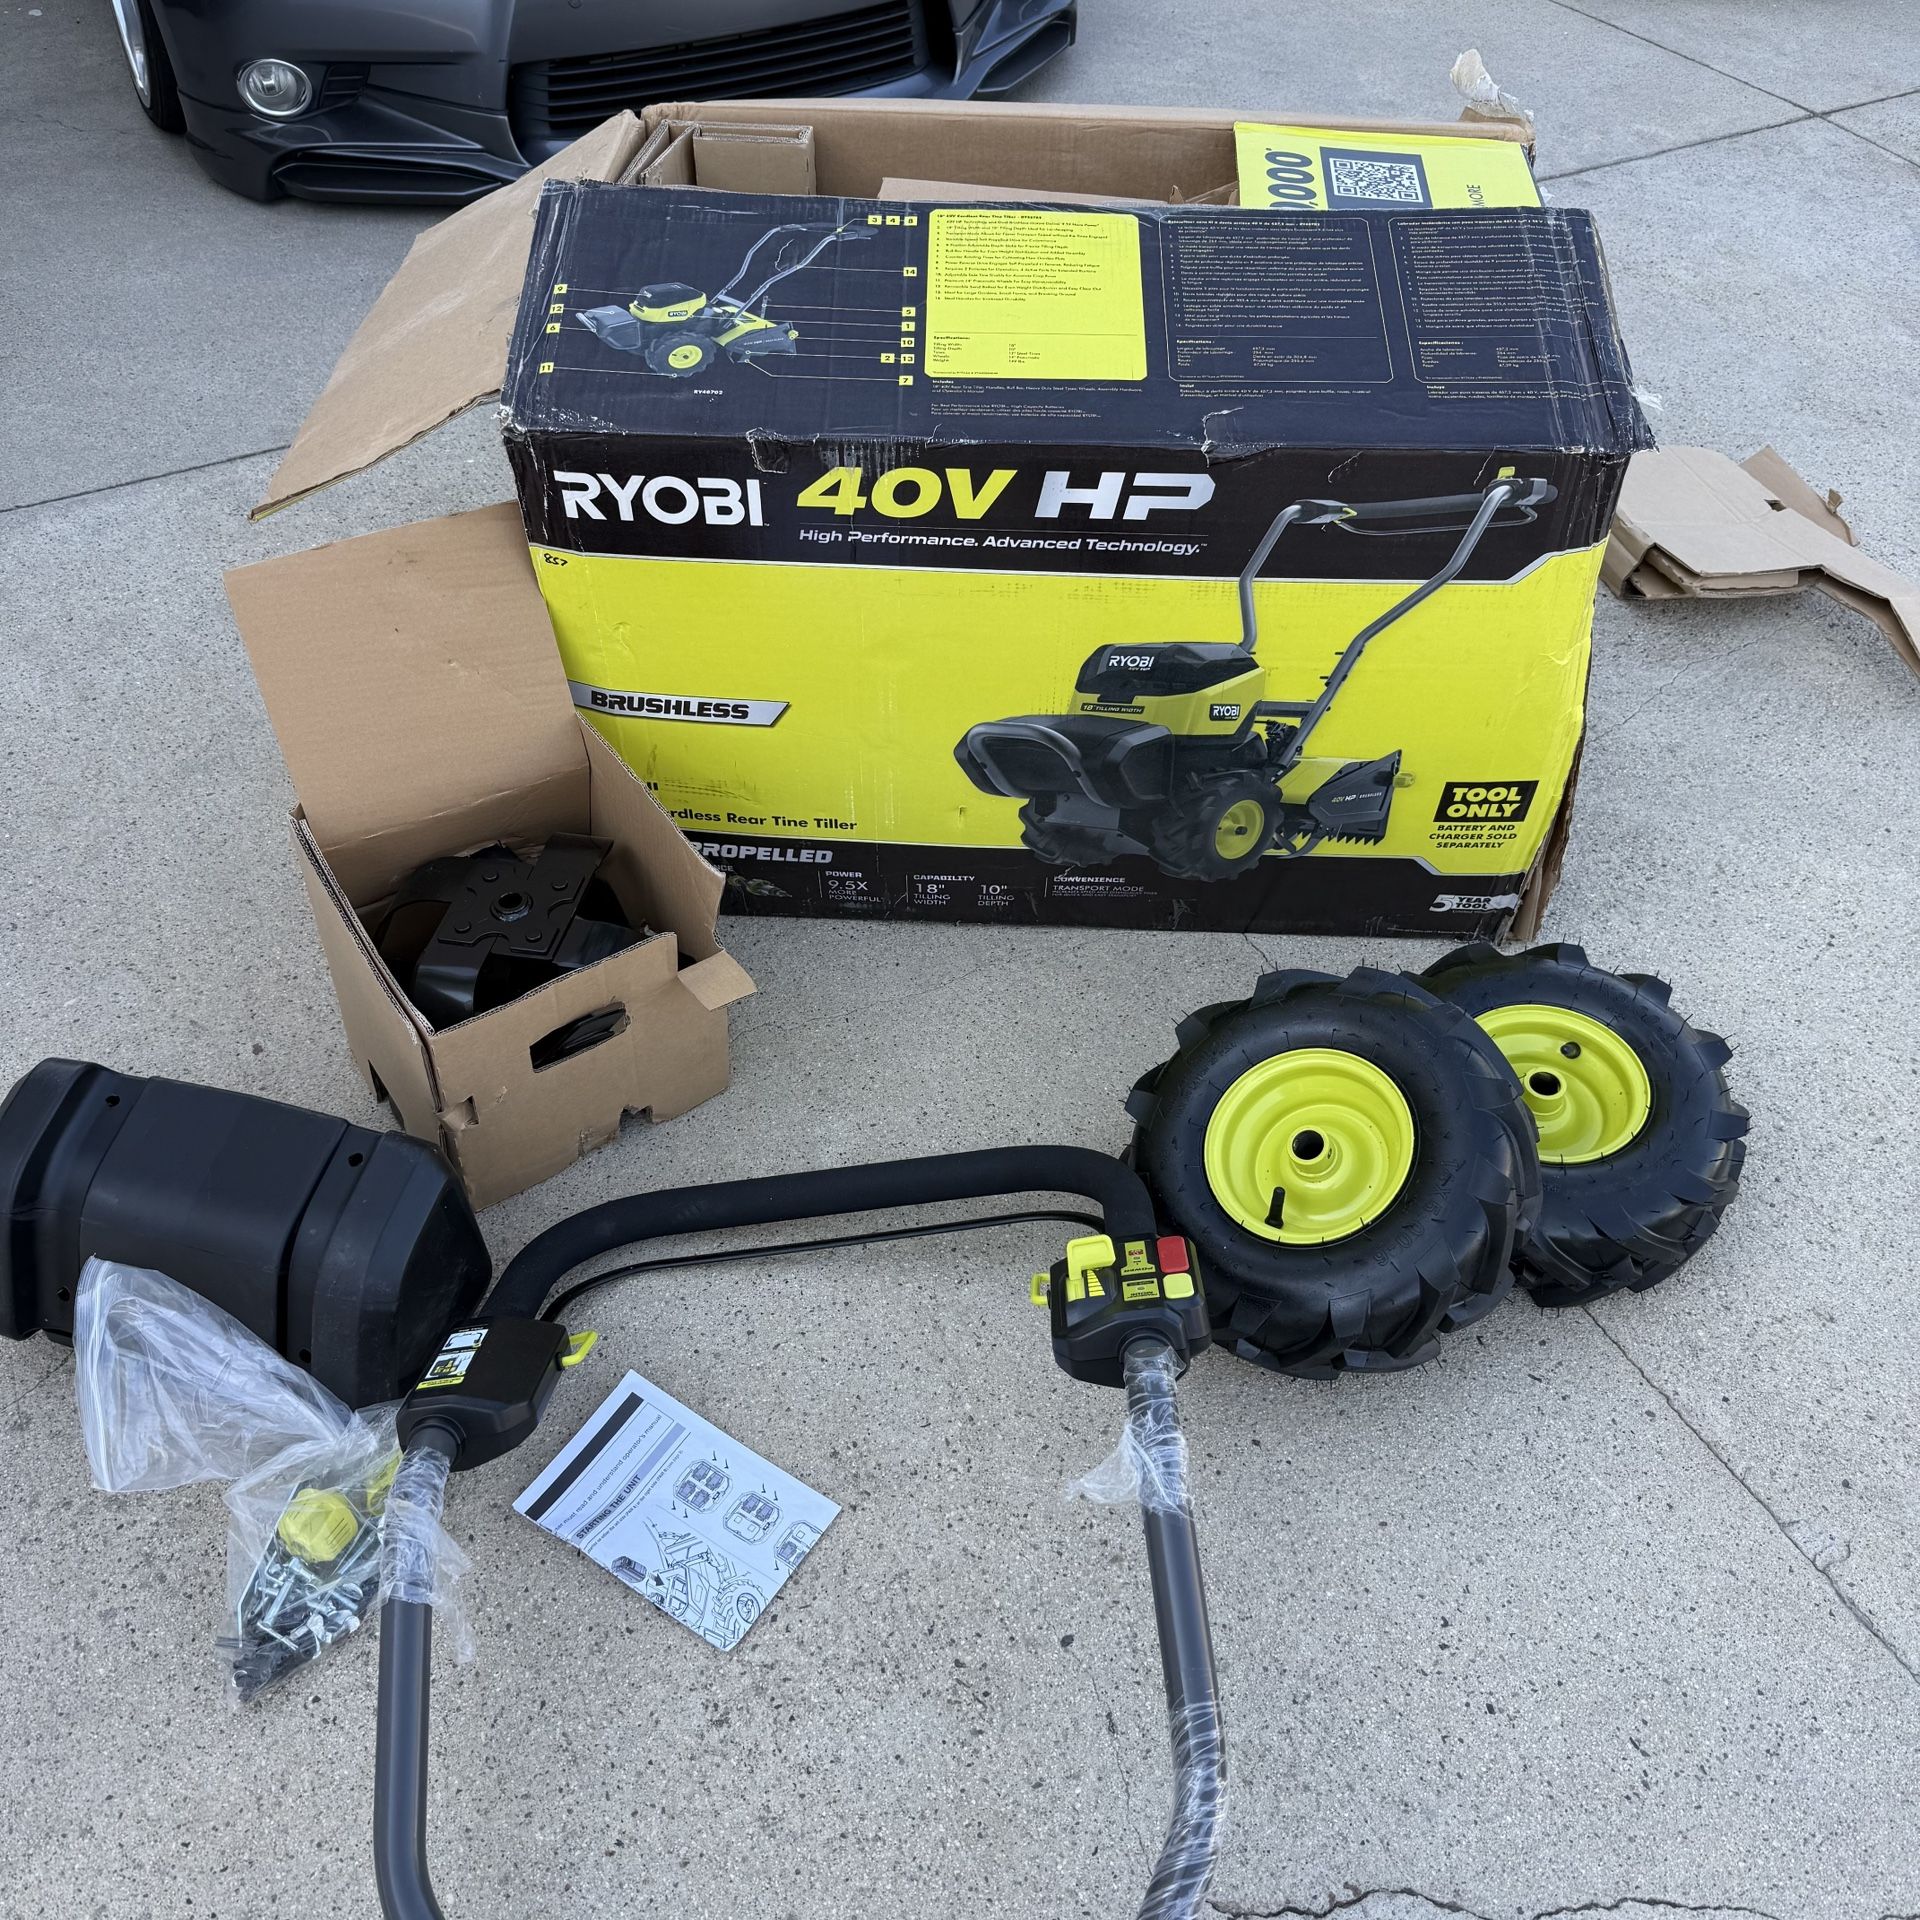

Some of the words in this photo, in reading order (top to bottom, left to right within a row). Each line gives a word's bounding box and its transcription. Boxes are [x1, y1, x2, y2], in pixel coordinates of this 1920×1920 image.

[553, 470, 764, 527] RYOBI
[796, 467, 1017, 519] 40V
[1034, 471, 1216, 520] HP
[799, 529, 842, 544] High
[847, 530, 979, 547] Performance.
[982, 535, 1082, 551] Advanced
[1085, 538, 1200, 555] Technology.
[1108, 655, 1155, 668] RYOBI
[590, 690, 749, 720] BRUSHLESS
[1212, 705, 1240, 717] RYOBI
[1452, 786, 1522, 802] TOOL
[1446, 803, 1521, 818] ONLY
[666, 808, 721, 822] rdless
[726, 812, 767, 826] Rear
[772, 815, 809, 829] Tine
[813, 818, 858, 831] Tiller
[1437, 824, 1486, 832] BATTERY
[1436, 841, 1505, 849] SEPARATELY
[825, 870, 863, 878] POWER
[828, 879, 869, 891] 9.5X
[915, 883, 945, 894] 18"
[980, 884, 1008, 895] 10"
[1112, 885, 1145, 893] MODE
[1429, 893, 1456, 912] 5
[1457, 896, 1492, 904] YEAR
[576, 1500, 589, 1513] read
[588, 1489, 599, 1502] and
[597, 1459, 624, 1490] understand
[622, 1434, 647, 1461] operator's
[644, 1414, 663, 1435] manual
[576, 1508, 612, 1540] STARTING
[610, 1494, 627, 1509] THE
[623, 1474, 642, 1495] UNIT
